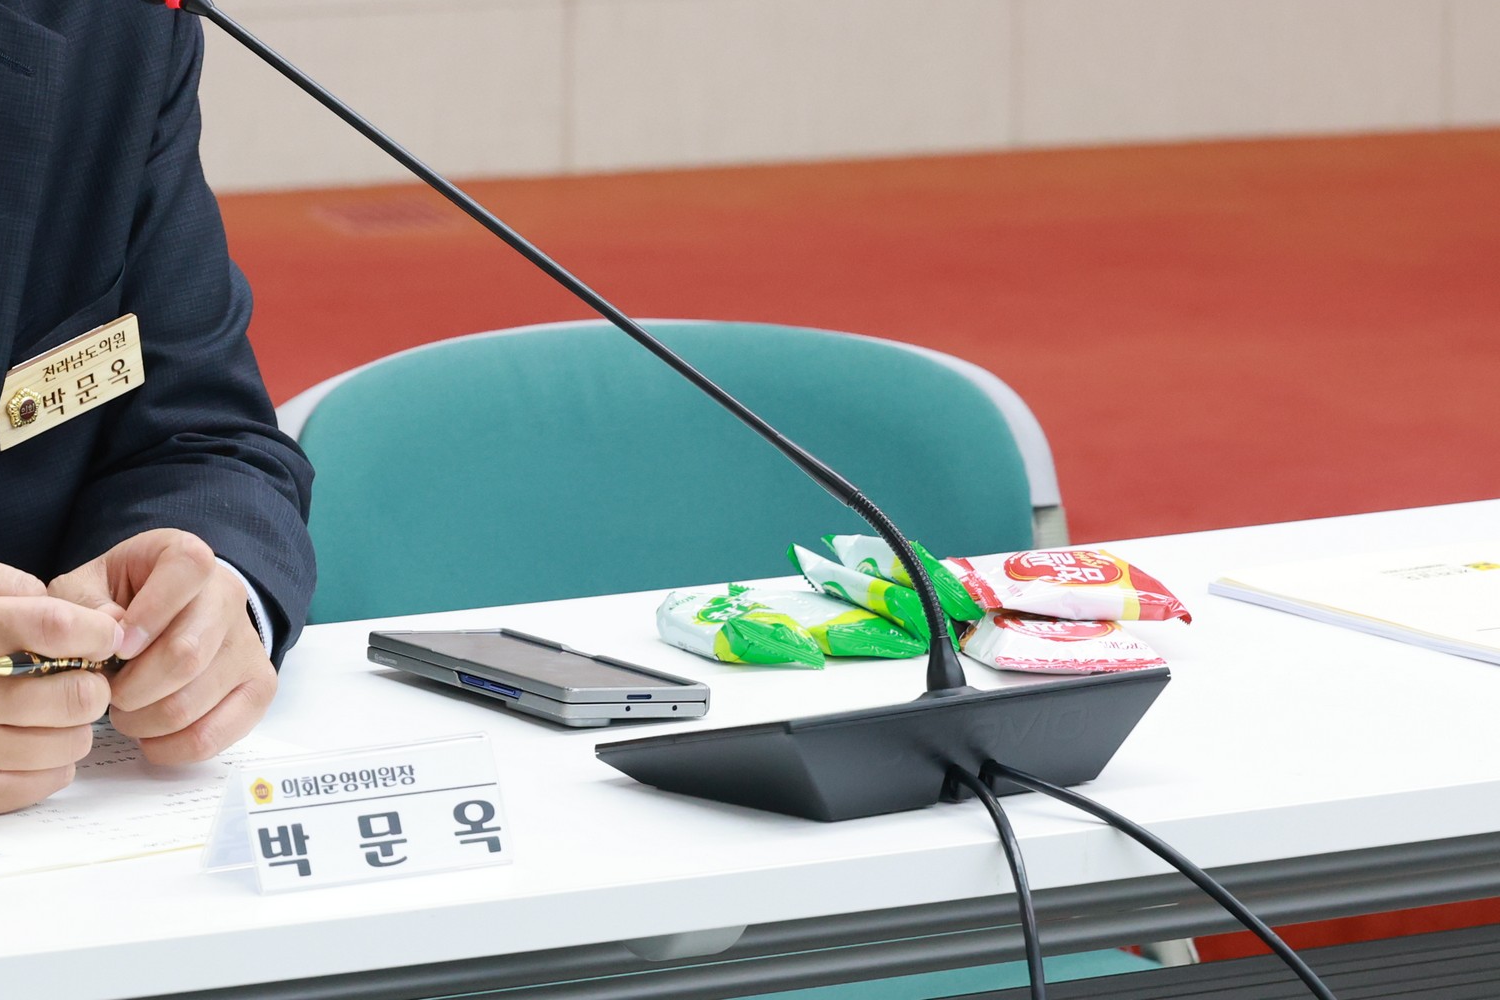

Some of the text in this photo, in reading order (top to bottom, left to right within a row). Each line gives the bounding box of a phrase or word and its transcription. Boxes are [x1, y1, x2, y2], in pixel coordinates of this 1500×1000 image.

[42, 331, 127, 382] 전라남도의원
[42, 358, 131, 416] 박 문 옥
[280, 764, 416, 799] 의회운영위원장
[257, 799, 502, 878] 박 문 옥
